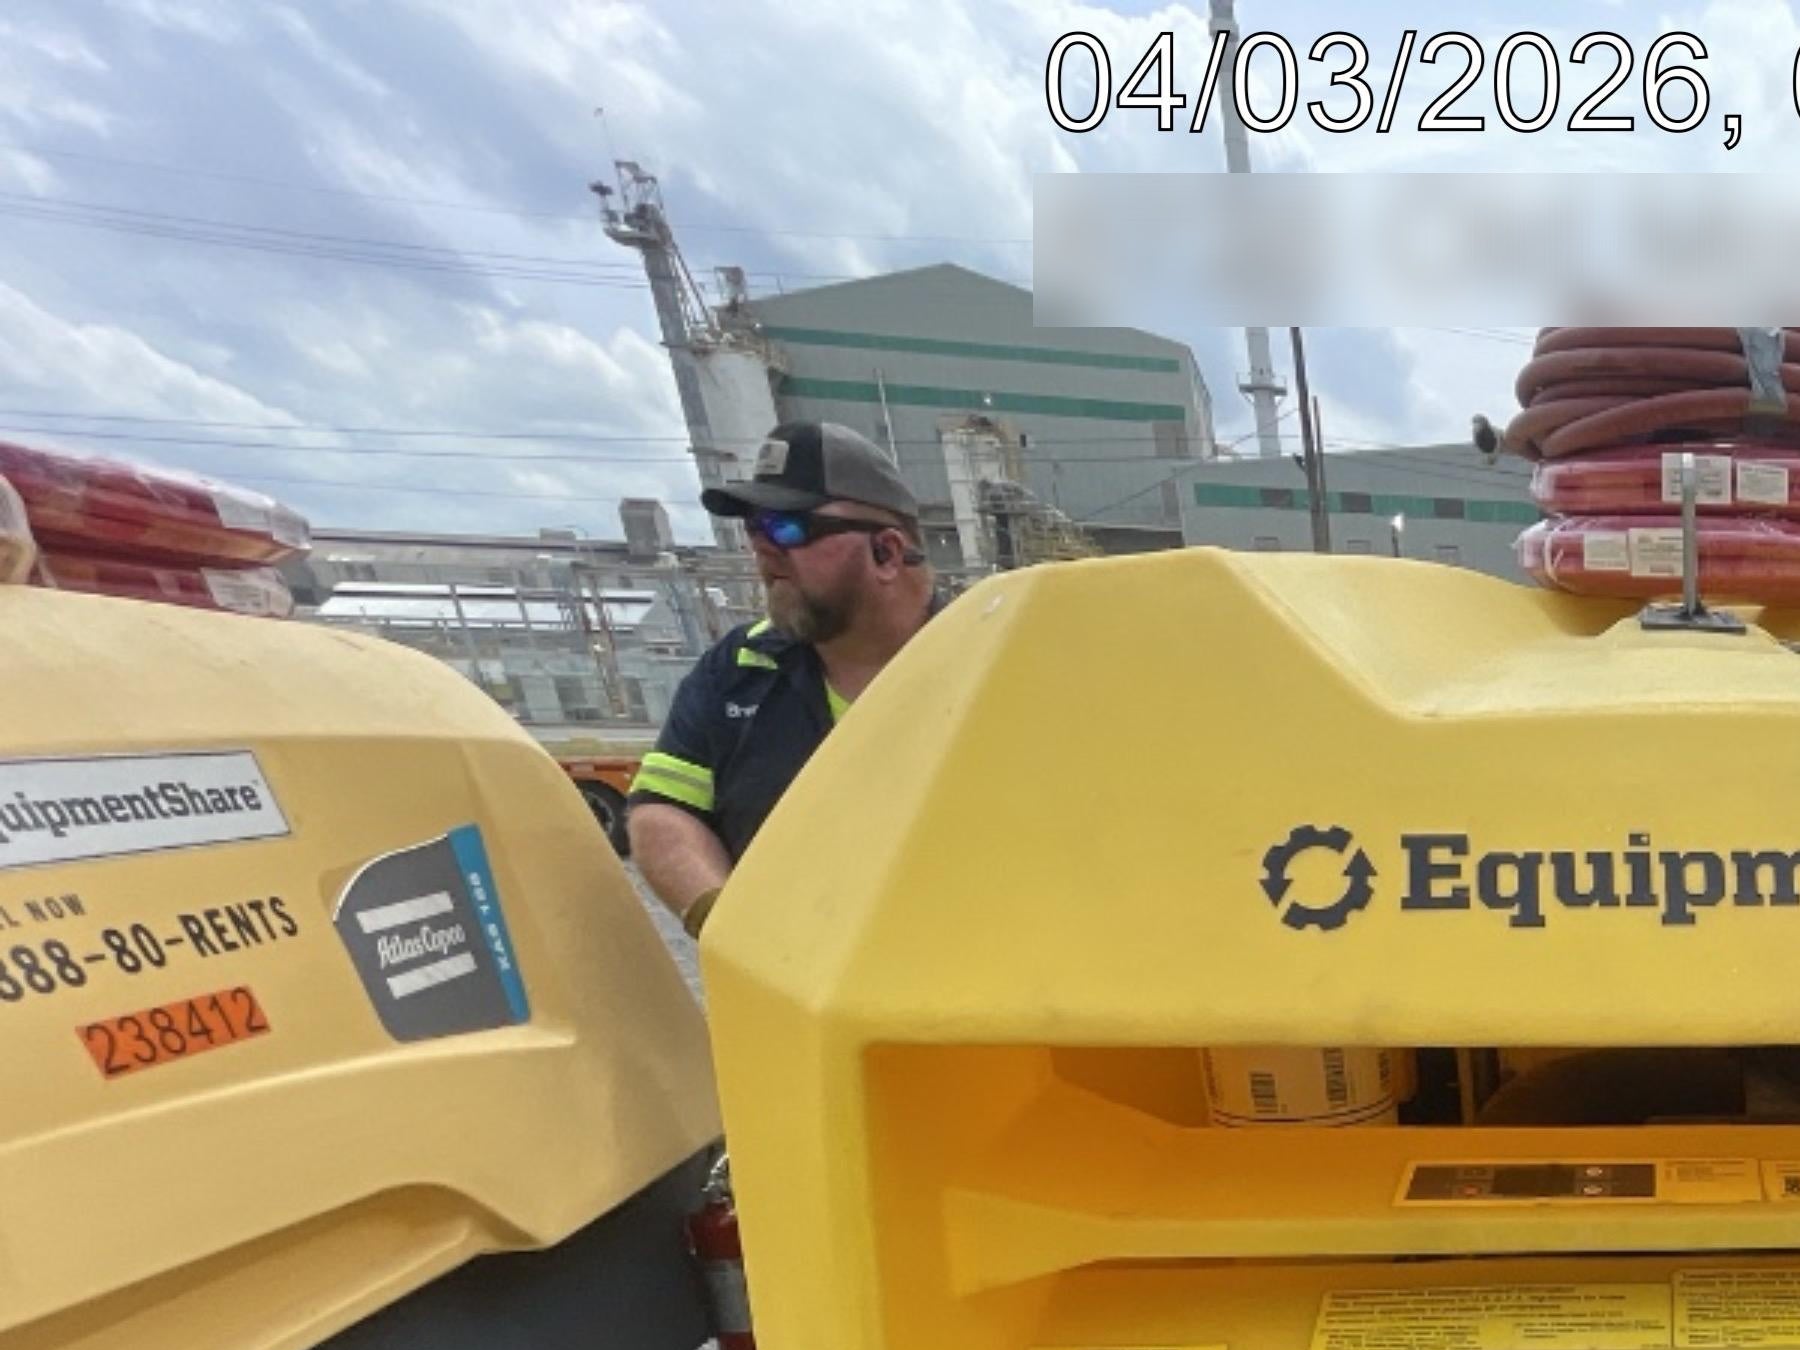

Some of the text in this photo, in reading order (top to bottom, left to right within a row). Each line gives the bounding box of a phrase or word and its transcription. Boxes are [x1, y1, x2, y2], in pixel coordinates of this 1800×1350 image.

[0, 782, 262, 843] uipmentShare
[24, 893, 86, 922] NOW
[86, 986, 269, 1075] 238412
